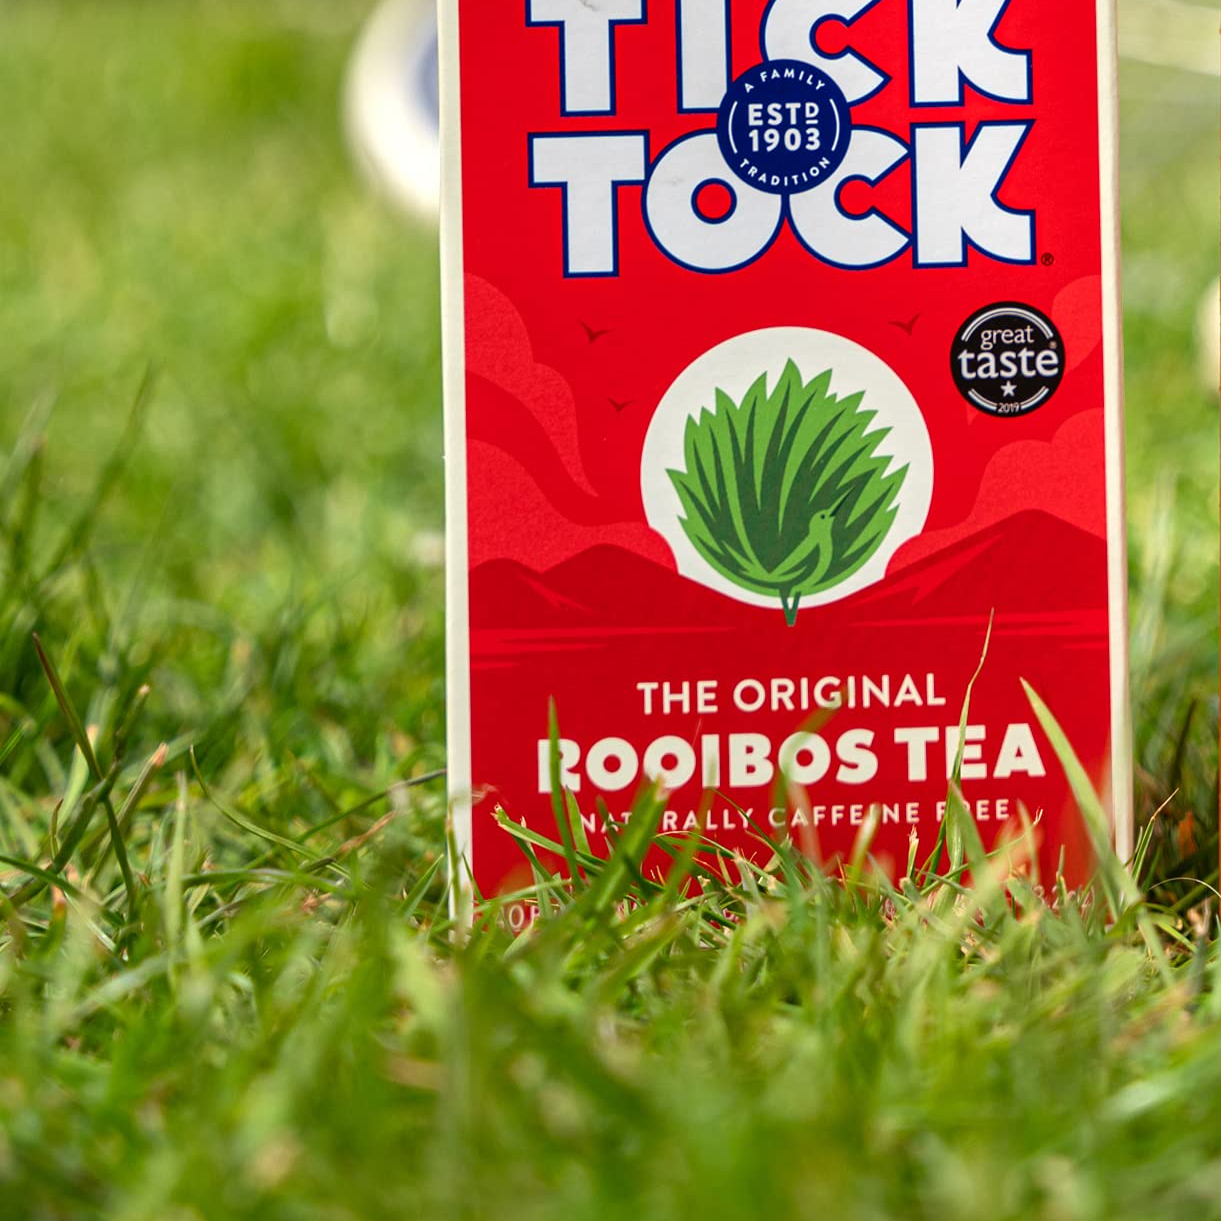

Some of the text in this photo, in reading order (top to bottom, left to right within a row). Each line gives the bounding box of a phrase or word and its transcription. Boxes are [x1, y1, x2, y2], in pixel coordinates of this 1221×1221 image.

[744, 67, 826, 94] A FAMILY
[748, 102, 820, 126] ESTD
[748, 127, 821, 153] 1903
[739, 156, 831, 187] TRADITION
[527, 118, 1038, 279] TOCK
[980, 325, 1034, 351] great
[957, 346, 1060, 380] taste
[997, 401, 1021, 414] 2019
[636, 673, 947, 716] THE ORIGINAL
[537, 722, 1047, 794] ROOIBOS TEA
[936, 798, 1010, 823] FEE
